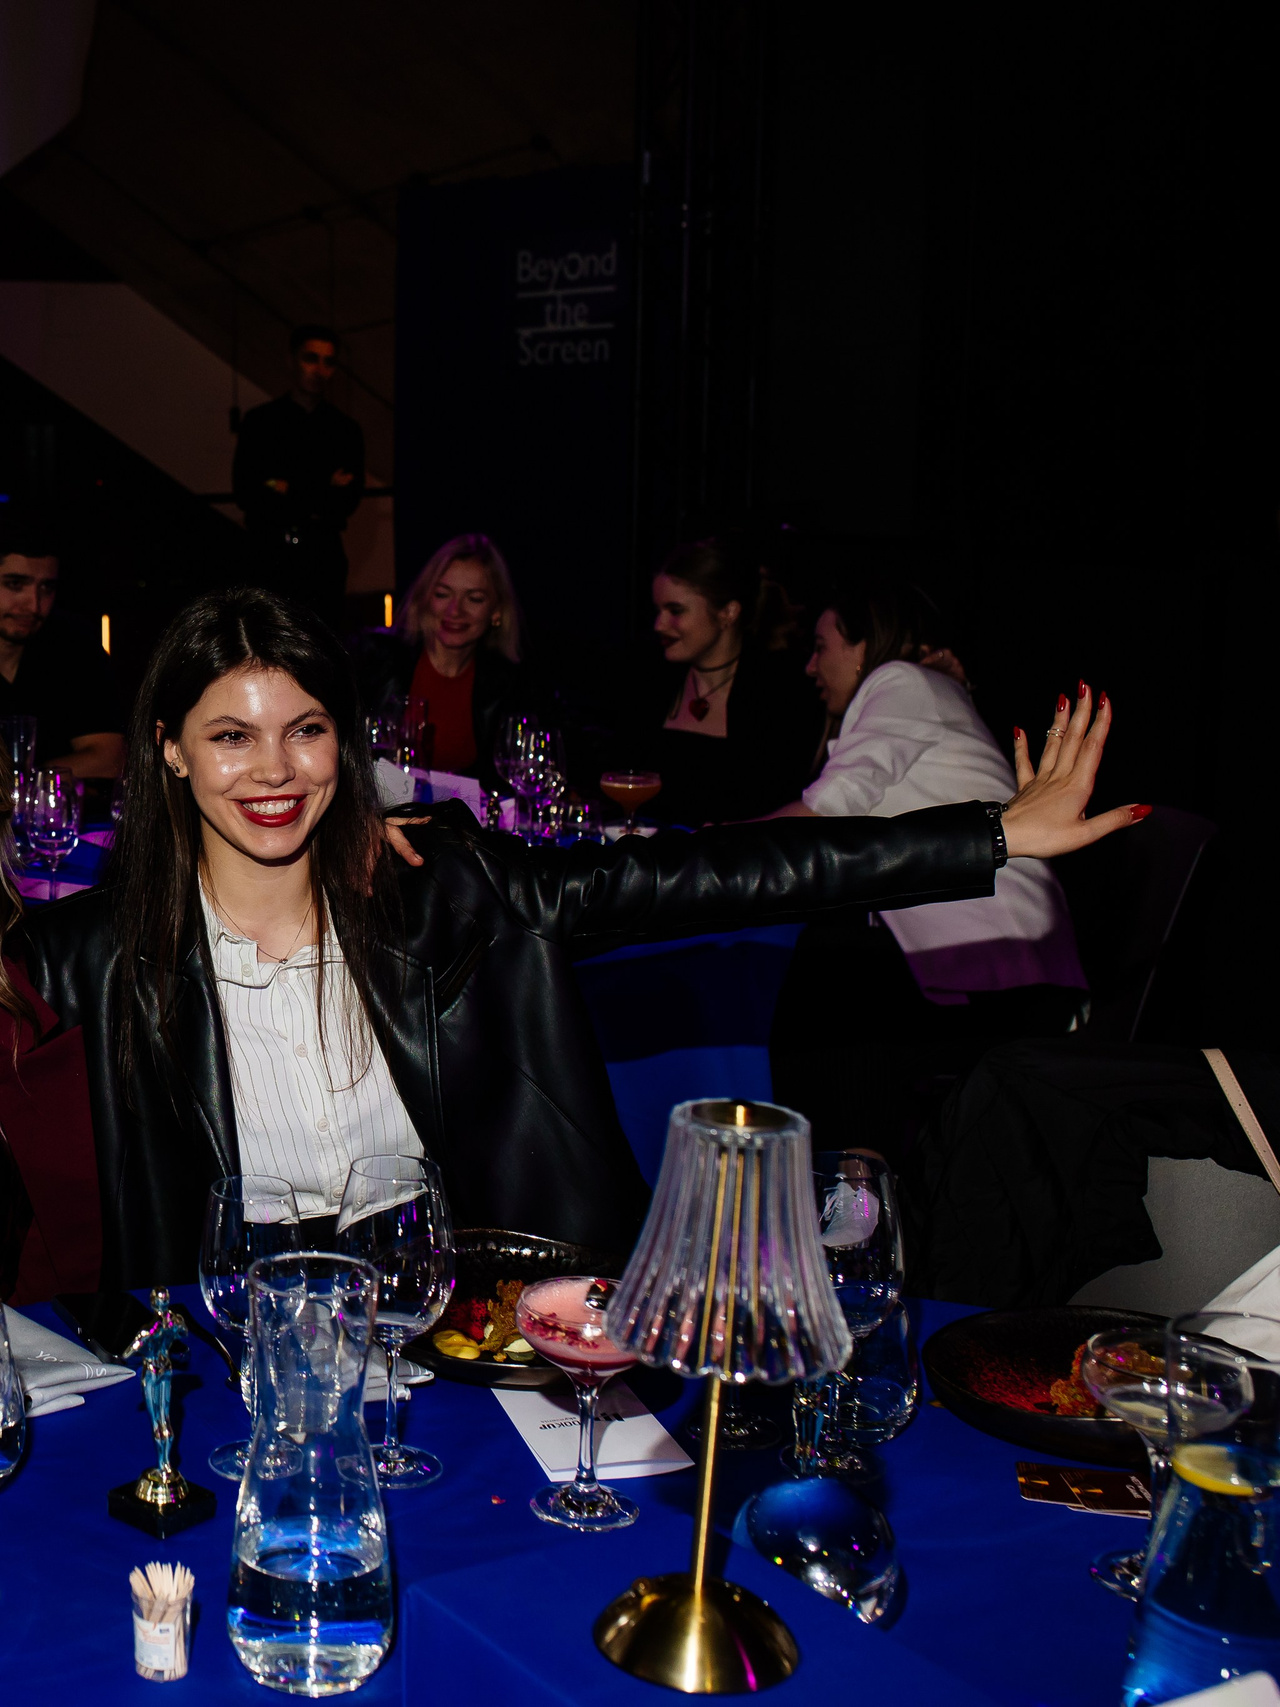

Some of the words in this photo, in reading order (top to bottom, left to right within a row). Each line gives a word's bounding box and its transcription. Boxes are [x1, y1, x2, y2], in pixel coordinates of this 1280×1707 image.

[516, 240, 618, 291] Beyond
[544, 294, 590, 328] the
[517, 330, 611, 366] Screen
[539, 1420, 583, 1430] OOKUP
